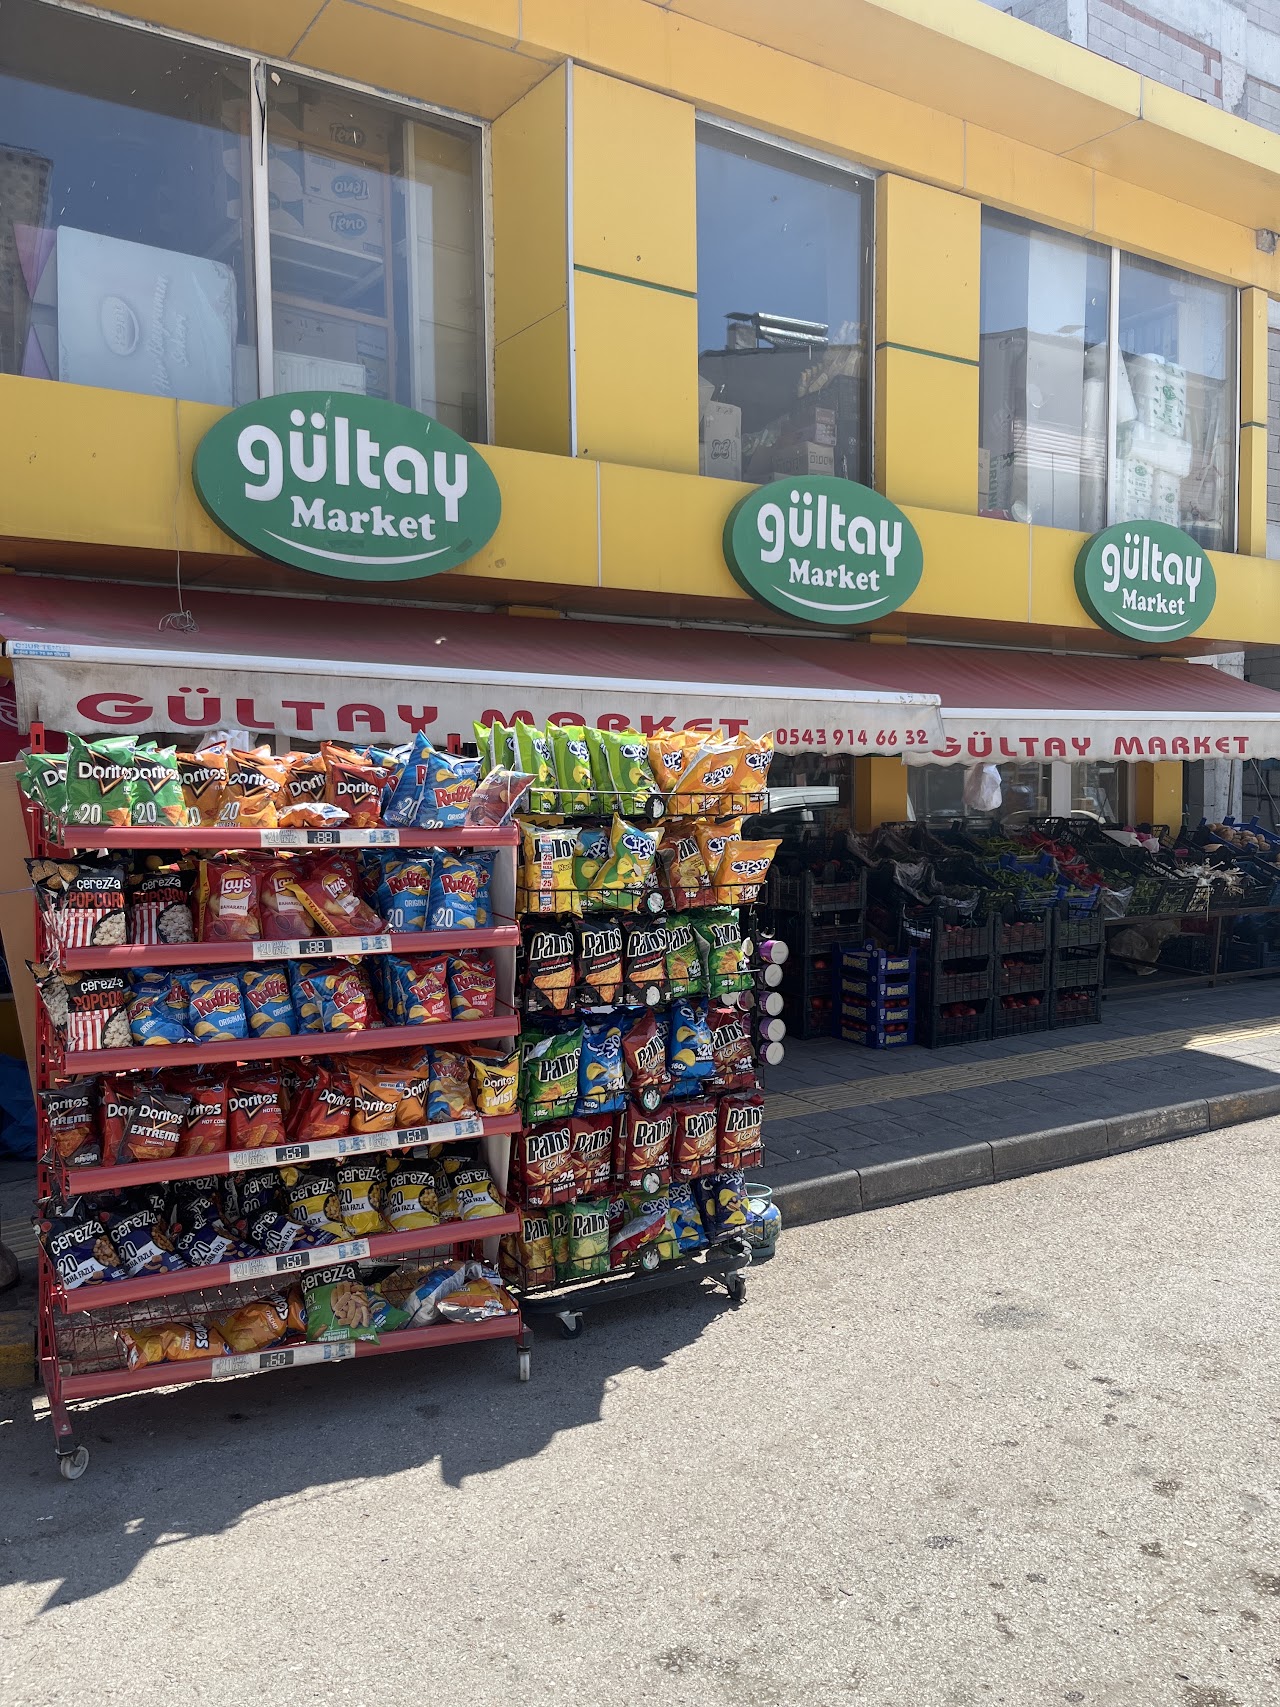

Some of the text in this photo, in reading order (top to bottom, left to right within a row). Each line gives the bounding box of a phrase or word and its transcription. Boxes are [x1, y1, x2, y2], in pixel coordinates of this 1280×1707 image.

[237, 409, 468, 523] gültay
[290, 495, 436, 541] Market
[756, 490, 902, 577] gültay
[788, 558, 880, 593] Market
[1101, 532, 1202, 602] gültay
[1122, 588, 1186, 616] Market
[77, 686, 438, 734] GÜLTAY
[776, 728, 929, 746] 0543 914 66 32
[931, 731, 1250, 759] GÜLTAY MARKET
[288, 773, 326, 797] Dorit
[69, 891, 126, 909] POPCORN
[404, 899, 427, 907] ORIGINA
[73, 989, 125, 1011] POPCOR
[402, 1078, 430, 1099] Dorit
[483, 1075, 516, 1088] Doritos
[228, 1093, 278, 1112] Doritos
[318, 1088, 352, 1107] Dorito
[354, 1096, 397, 1113] Doritos
[139, 1105, 184, 1124] Doritos
[186, 1102, 222, 1116] ritos
[130, 1124, 180, 1142] EXTREME
